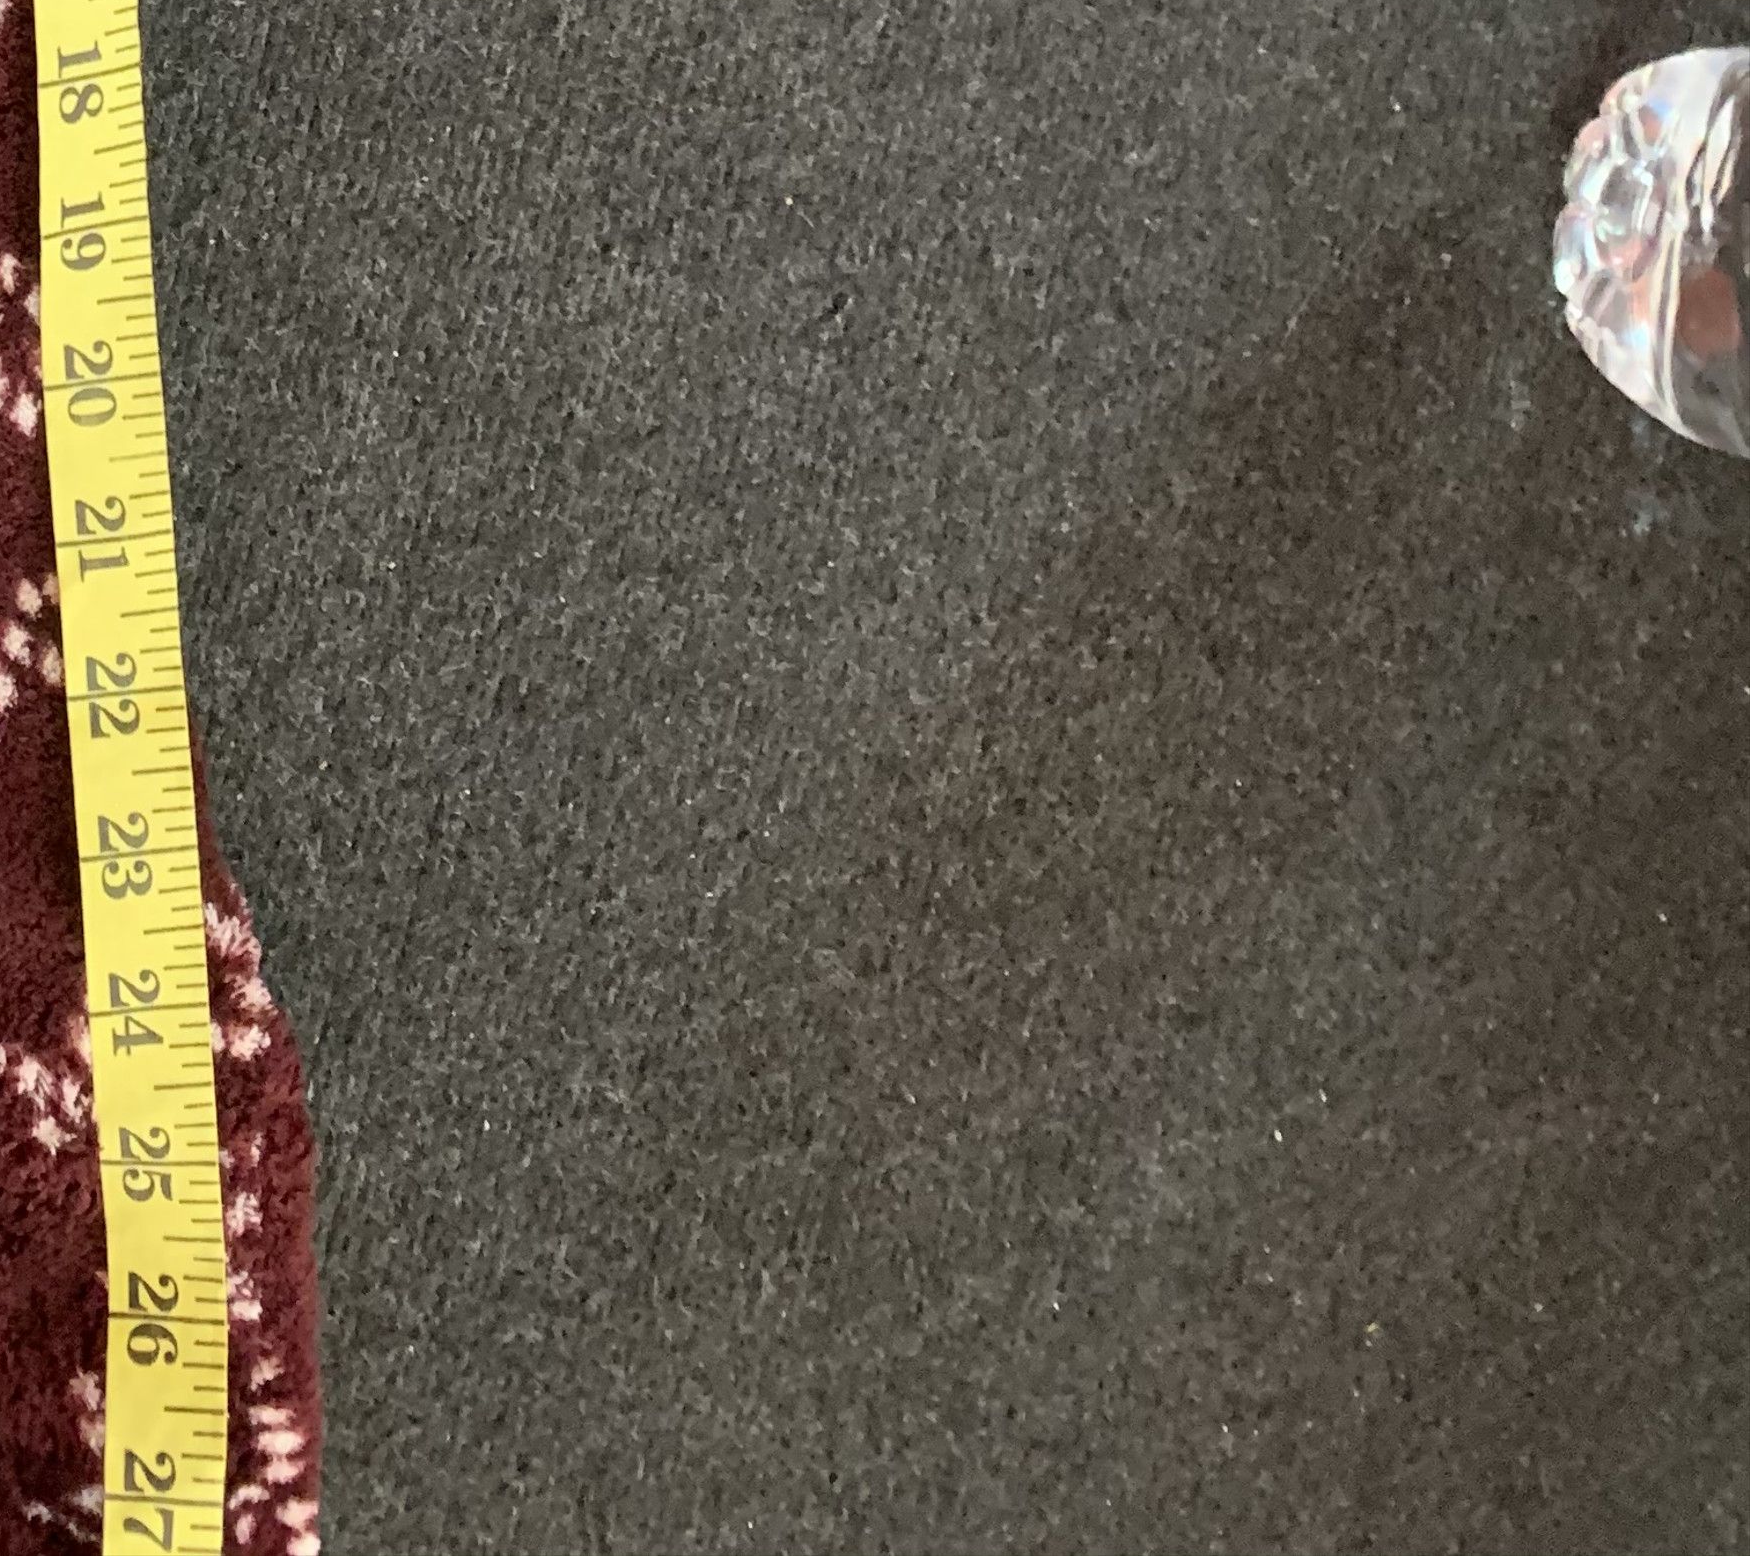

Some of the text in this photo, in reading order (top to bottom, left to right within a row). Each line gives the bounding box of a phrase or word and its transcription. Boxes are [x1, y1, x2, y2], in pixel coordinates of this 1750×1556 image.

[56, 40, 104, 125] 18
[59, 192, 107, 272] 19
[63, 340, 117, 427] 20
[75, 496, 129, 583] 21
[85, 653, 141, 739] 22
[97, 812, 153, 900] 23
[108, 969, 164, 1057] 24
[118, 1126, 173, 1203] 25
[126, 1271, 178, 1366] 26
[123, 1448, 176, 1553] 27
